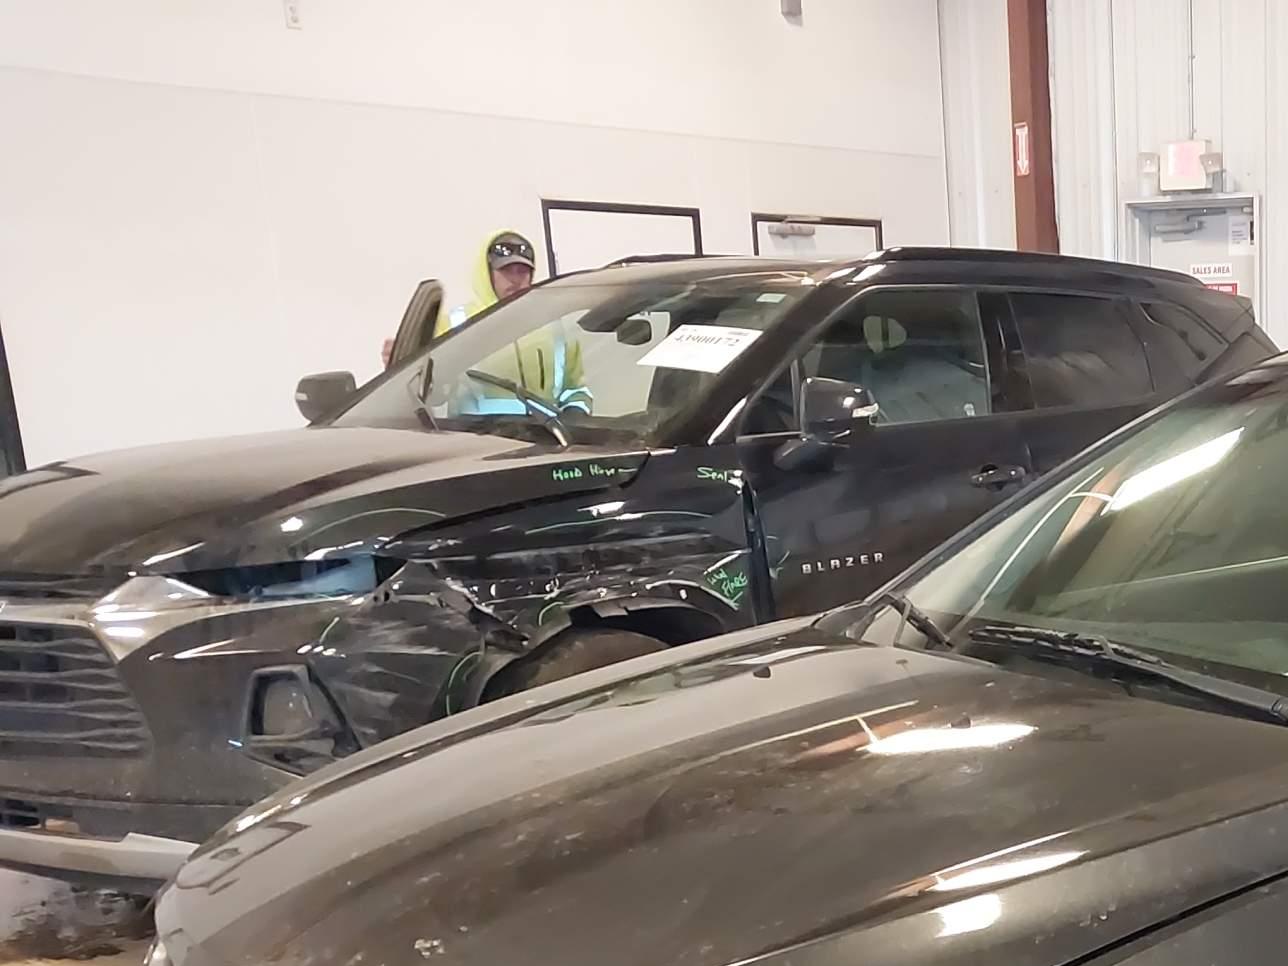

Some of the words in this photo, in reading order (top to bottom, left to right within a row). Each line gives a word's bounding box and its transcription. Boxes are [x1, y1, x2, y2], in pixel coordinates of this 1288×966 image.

[1192, 266, 1211, 274] SALES
[1213, 266, 1230, 274] AREA
[802, 552, 884, 574] BLAZER
